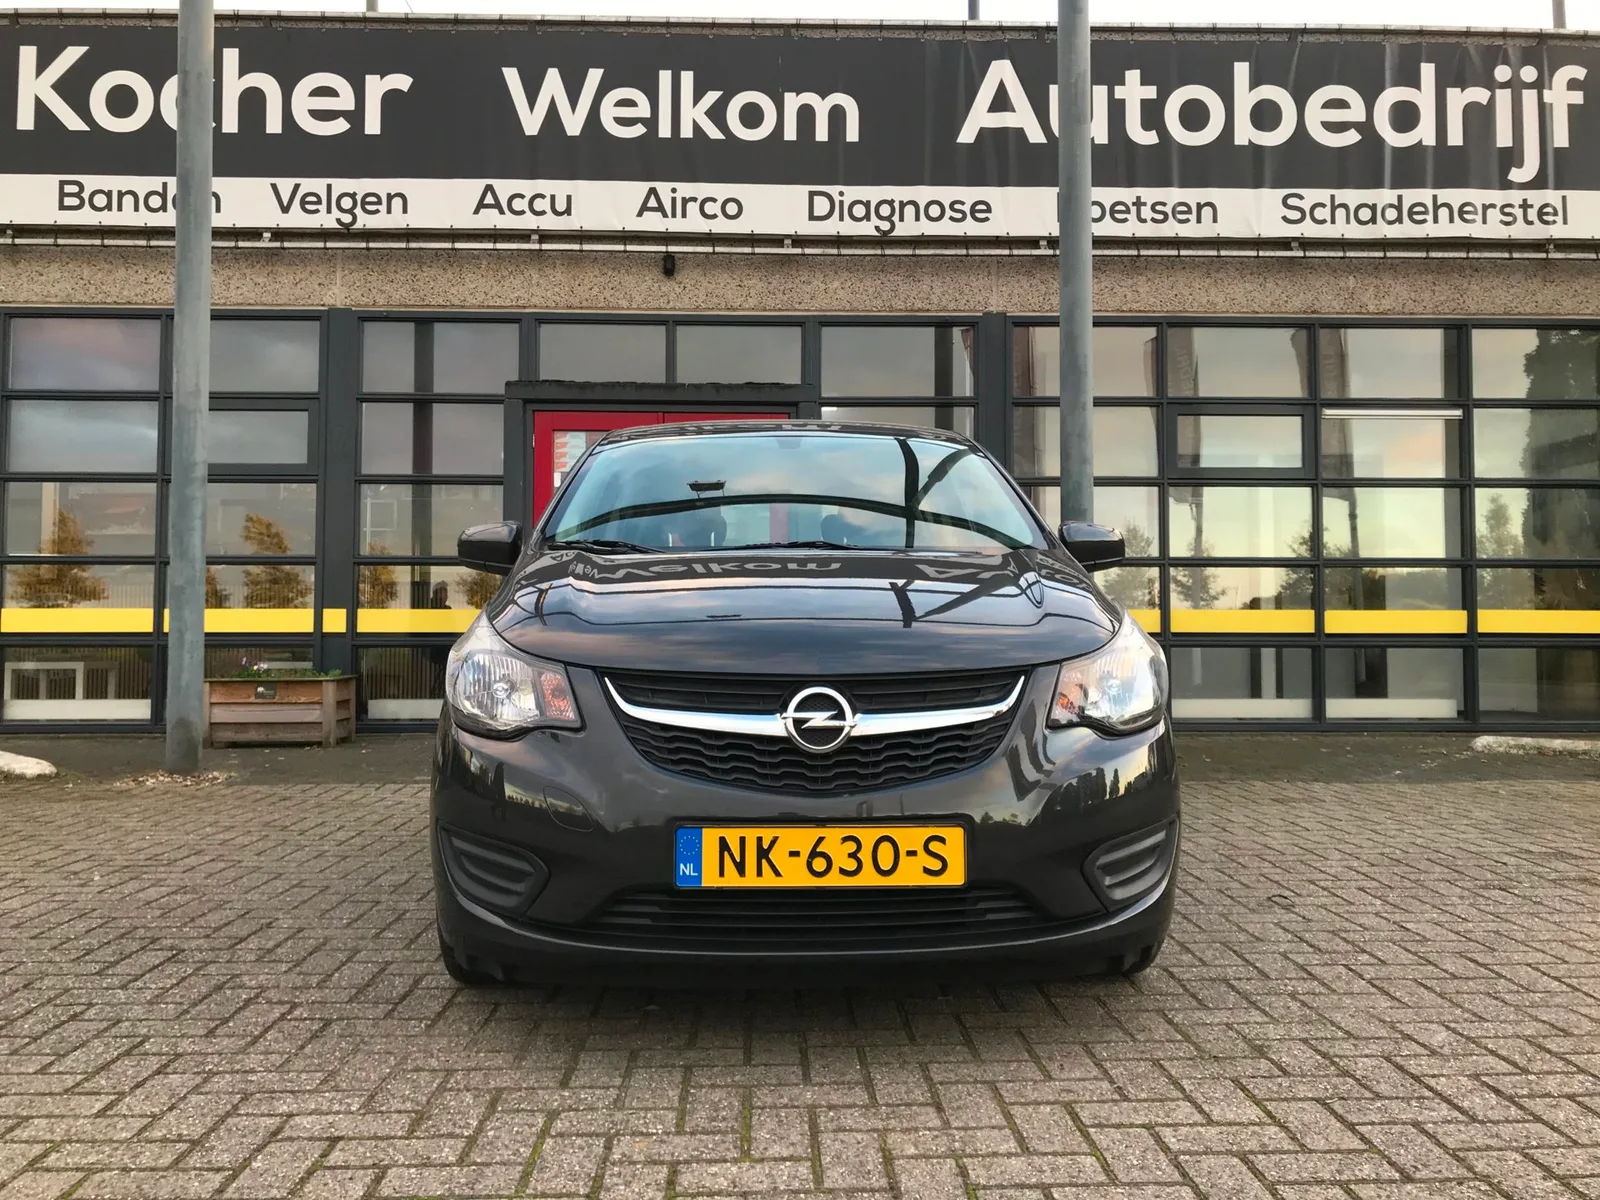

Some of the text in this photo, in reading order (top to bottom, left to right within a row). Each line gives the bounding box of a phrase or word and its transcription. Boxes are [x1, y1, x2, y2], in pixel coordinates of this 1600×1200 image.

[502, 66, 860, 142] Welkom
[956, 59, 1588, 183] Autobedrijf
[58, 180, 1569, 236] Bandn Velgen Accu Airco Diagnose oetsen Schadeherstel
[679, 834, 949, 879] NL NK-630-S
